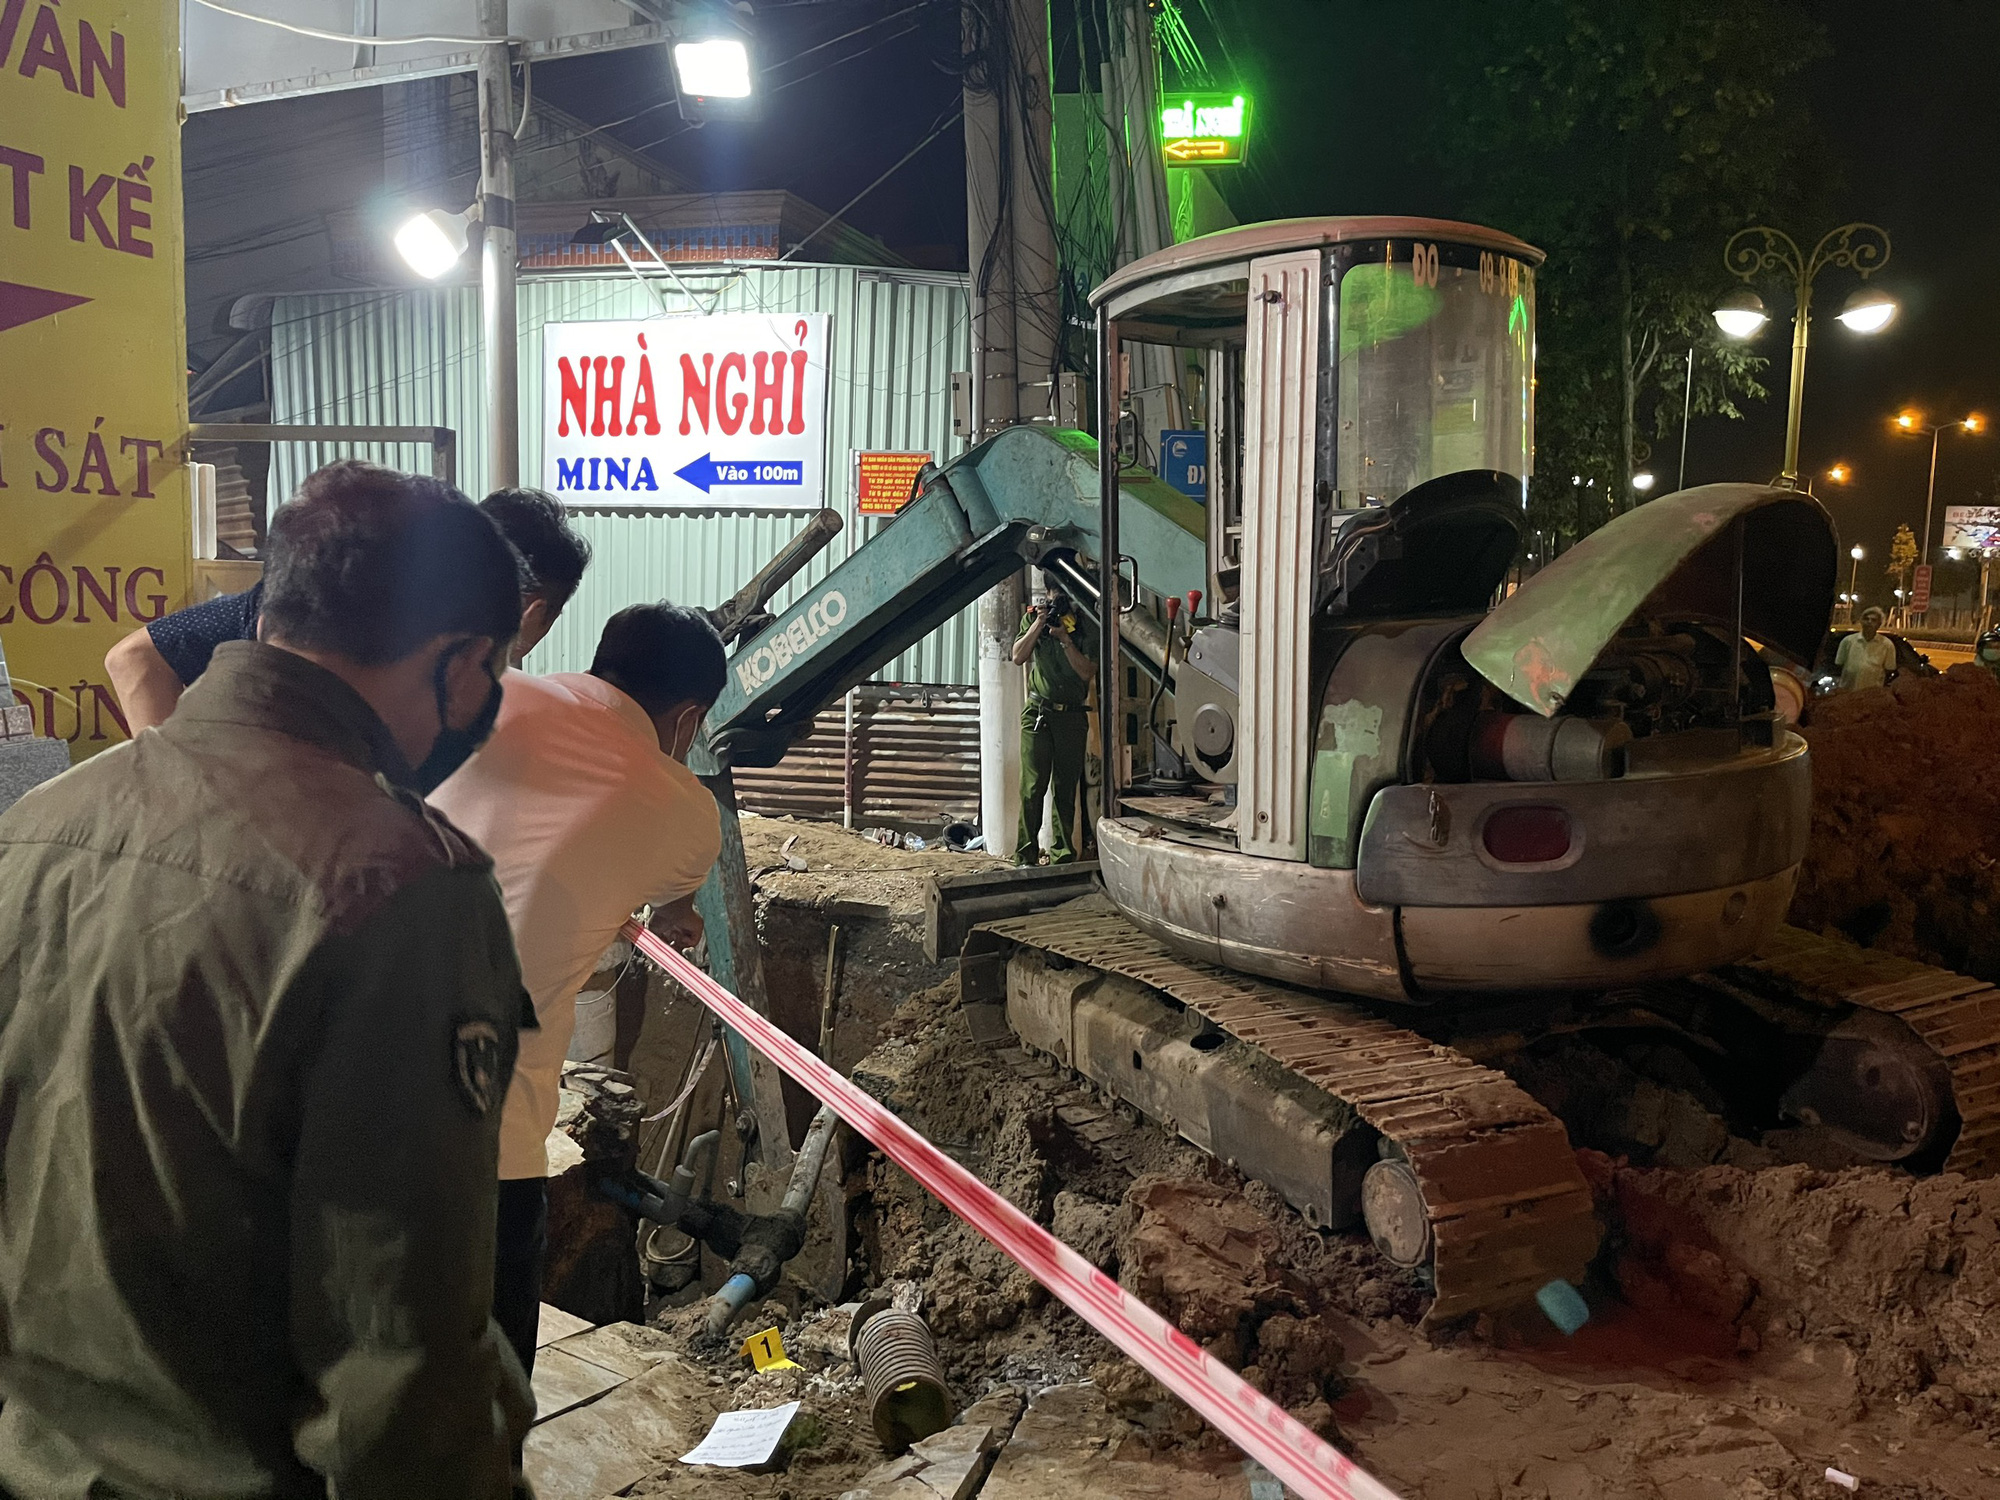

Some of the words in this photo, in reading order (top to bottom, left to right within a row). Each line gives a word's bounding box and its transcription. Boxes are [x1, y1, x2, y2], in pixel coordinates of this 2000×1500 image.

[68, 155, 155, 259] KẾ
[557, 332, 662, 438] NHÀ
[678, 319, 808, 437] NGHỈ
[34, 416, 164, 499] SÁT
[556, 456, 660, 491] MINA
[716, 465, 748, 481] Vào
[753, 465, 799, 481] 100m
[735, 590, 847, 696] KOBELCO
[759, 1335, 773, 1359] 1
